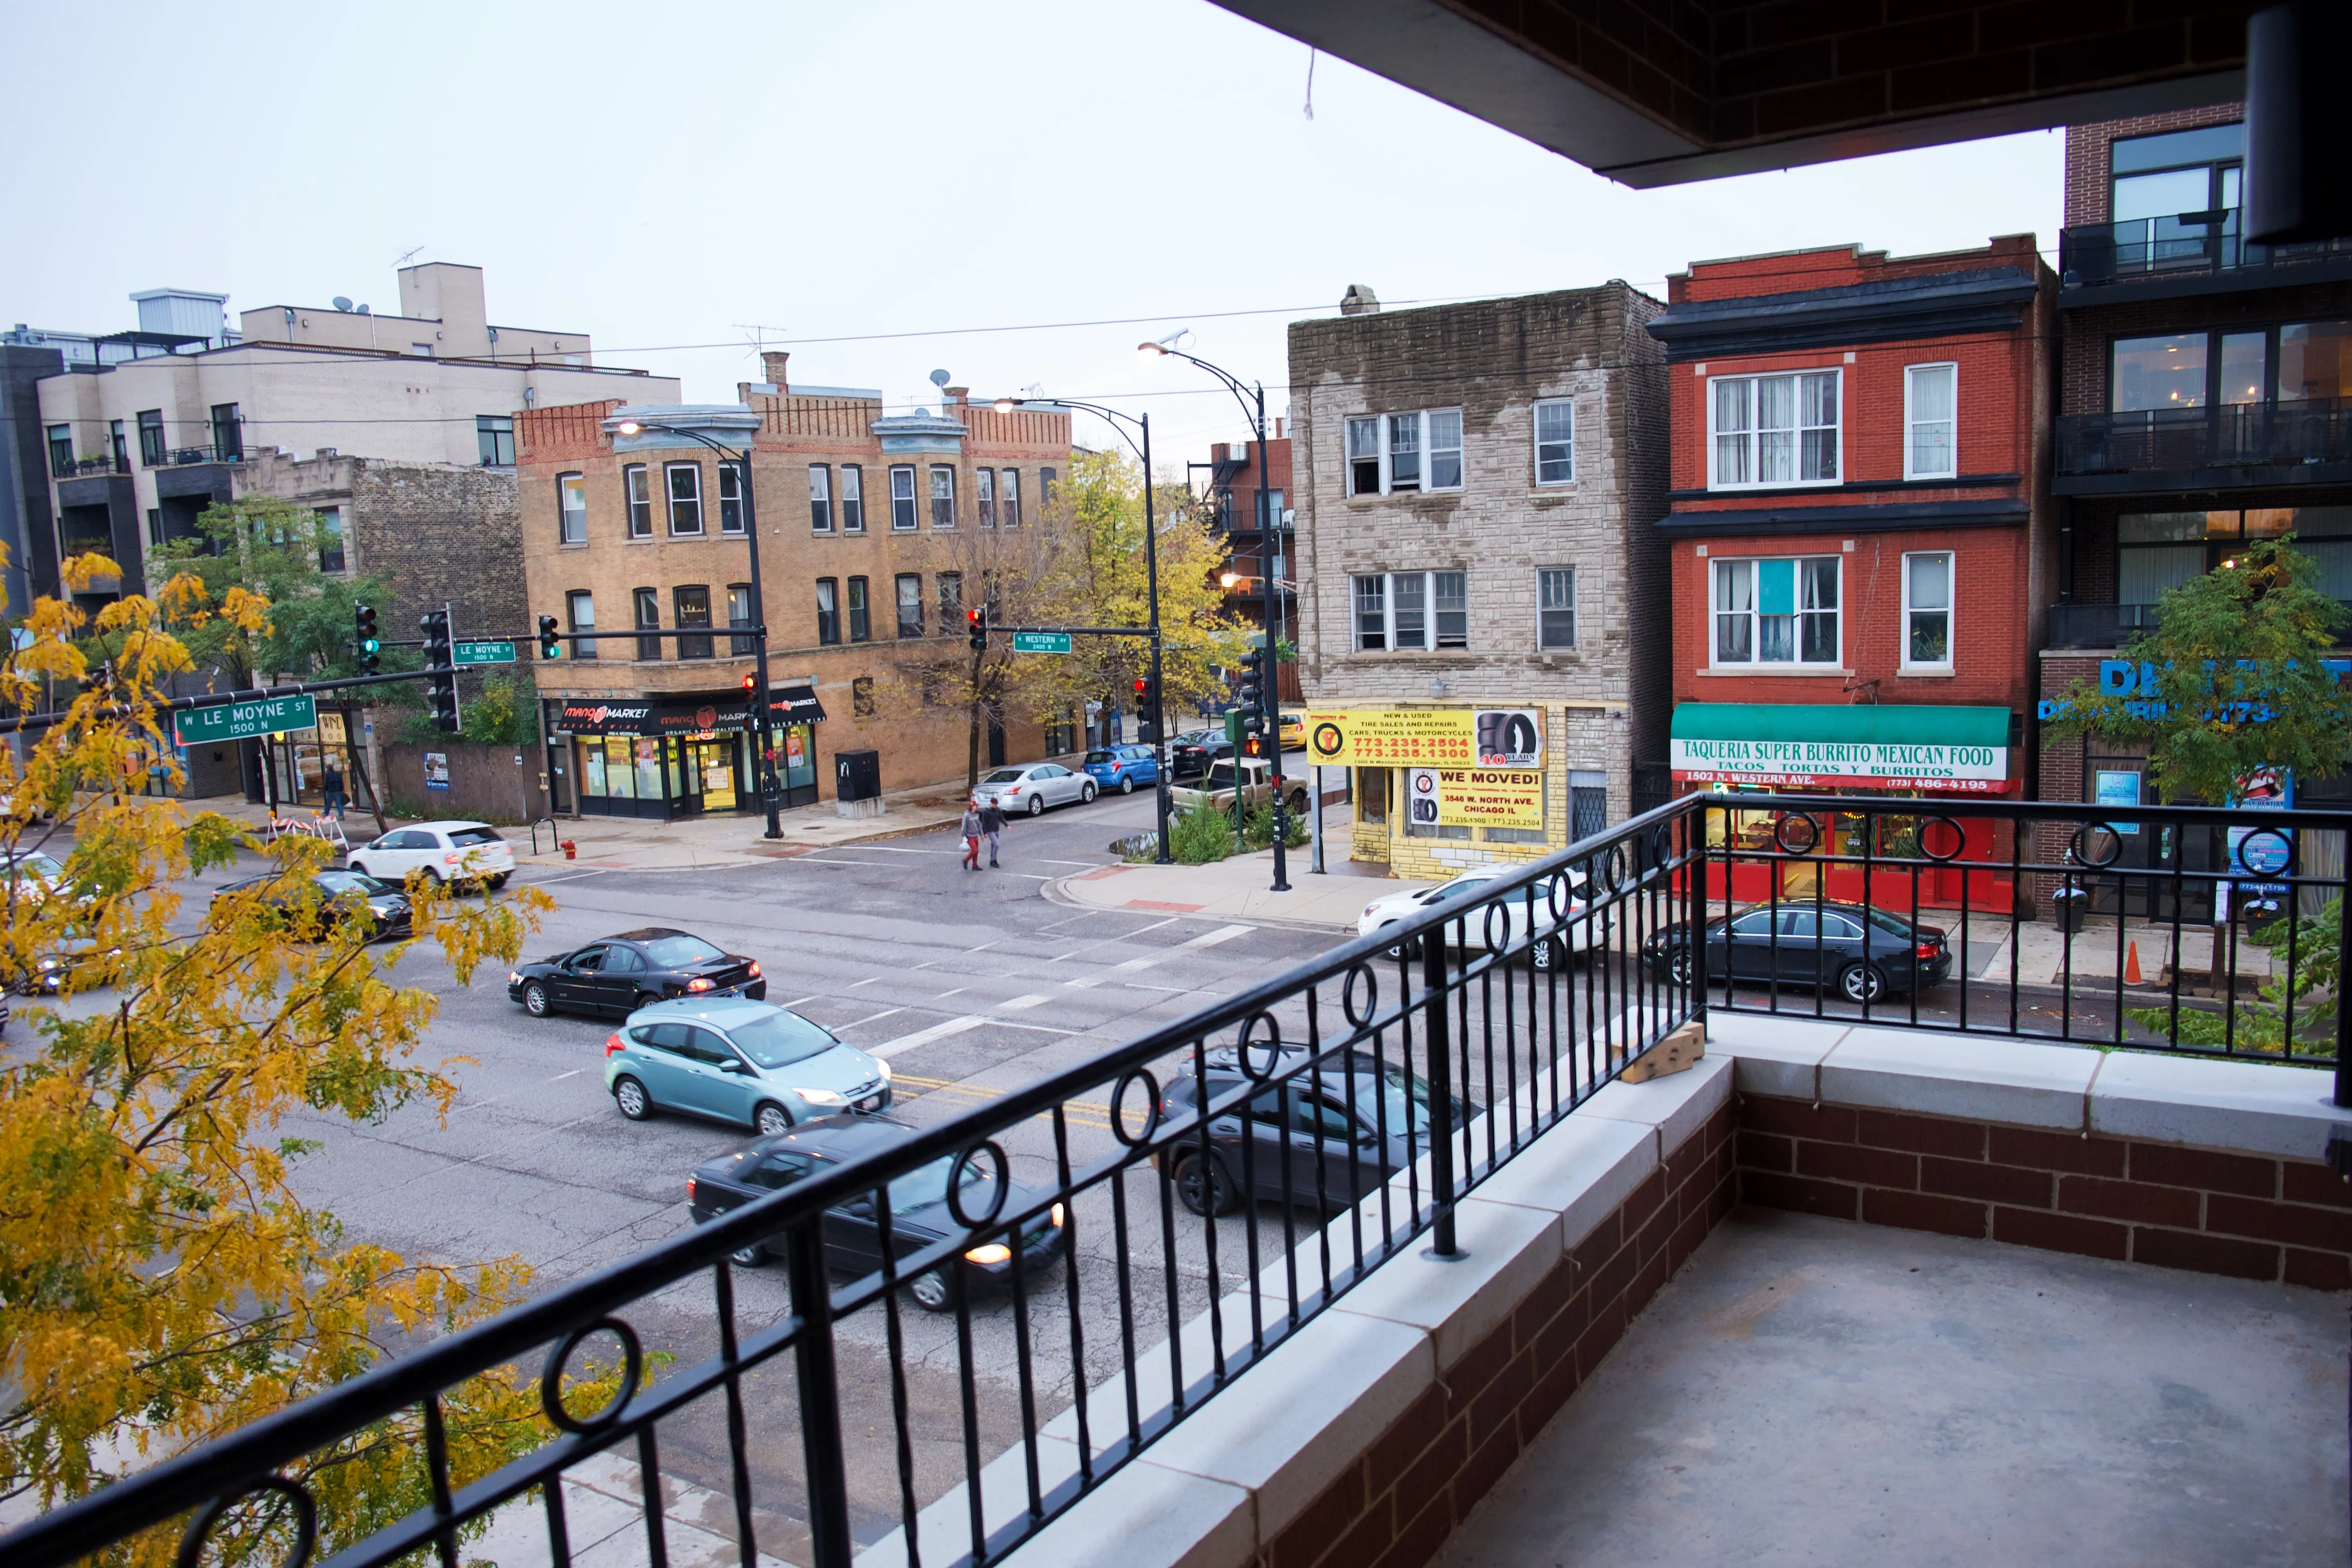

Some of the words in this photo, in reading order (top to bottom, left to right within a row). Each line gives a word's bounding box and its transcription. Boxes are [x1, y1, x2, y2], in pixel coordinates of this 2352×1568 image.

[461, 646, 470, 654] LE
[475, 645, 501, 654] MOYNE
[790, 698, 816, 707] MARKET
[184, 716, 193, 726] W
[204, 710, 223, 725] LE
[233, 702, 285, 722] MOYNE
[295, 701, 306, 711] ST
[605, 708, 649, 718] MARKET
[230, 722, 254, 734] 1500
[261, 721, 268, 730] N
[1354, 738, 1469, 747] 773.235.2504
[1354, 748, 1469, 758] 773.235.1300
[1683, 741, 1751, 760] TAQUERIA
[1755, 743, 1801, 760] SUPER
[1807, 744, 1871, 762] BURRITO
[1876, 746, 1943, 764] MEXICAN
[1950, 747, 1993, 766] FOOD
[1479, 754, 1506, 765] 40
[1716, 761, 1765, 771] TACOS
[1780, 763, 1840, 773] TORTAS
[1850, 765, 1860, 774] Y
[1871, 766, 1953, 777] BURRITOS
[1440, 772, 1465, 782] WE
[1471, 773, 1538, 784] MOVED!
[1687, 772, 1713, 781] 1502
[1716, 772, 1728, 782] N.
[1731, 772, 1787, 784] WESTERN
[1788, 775, 1815, 784] AVE.
[1887, 779, 1911, 787] (773)
[1914, 778, 1987, 789] 486-4195
